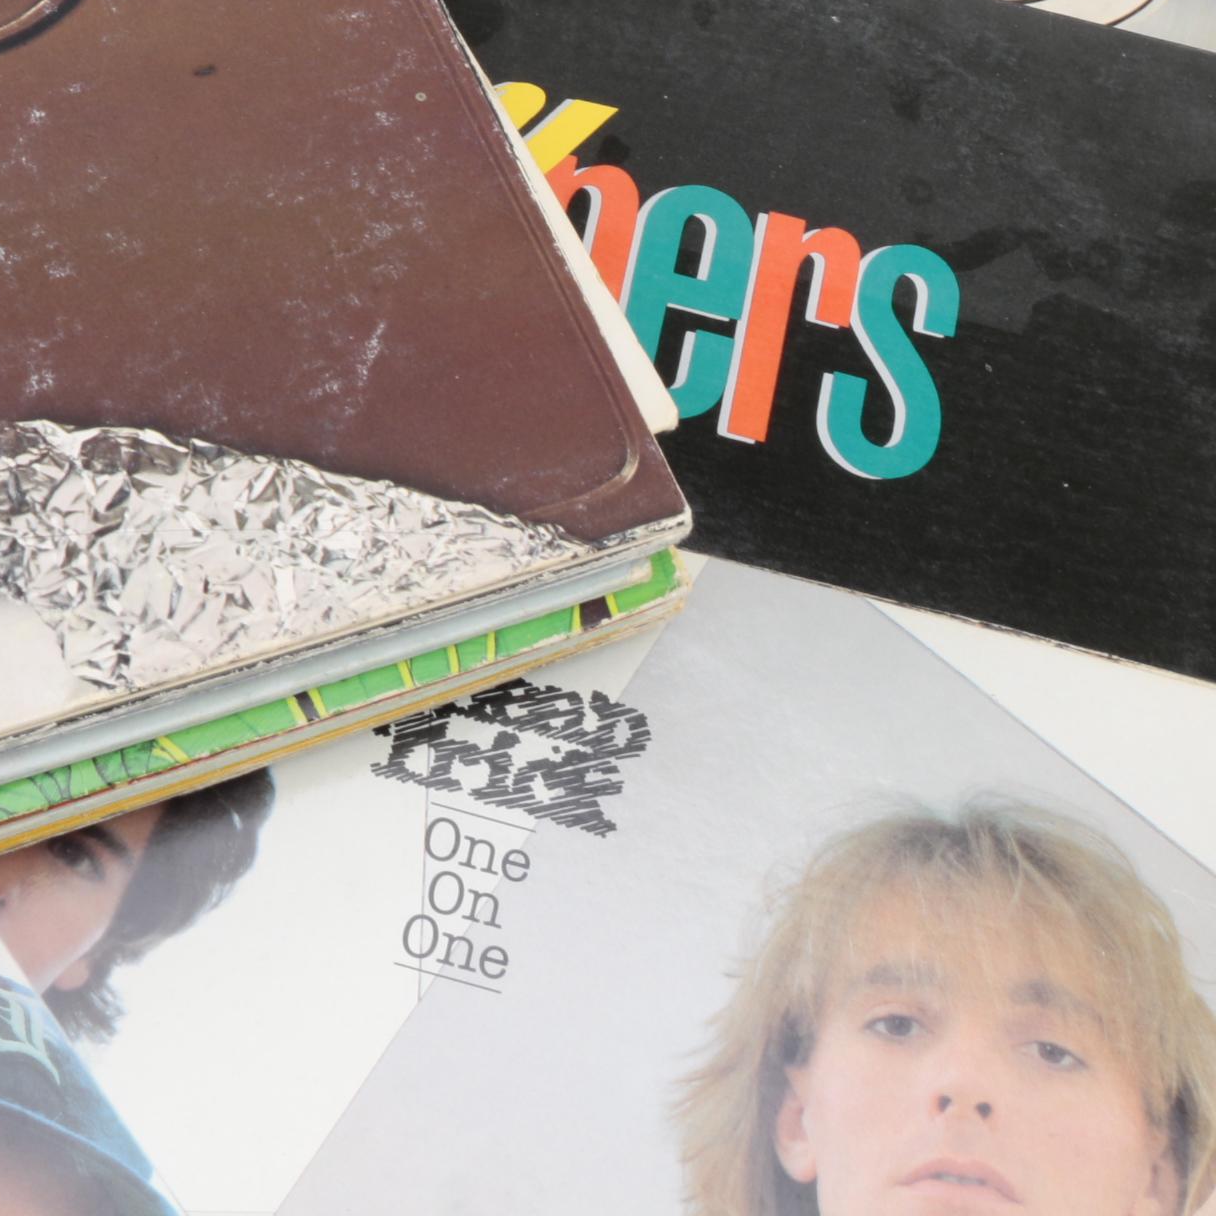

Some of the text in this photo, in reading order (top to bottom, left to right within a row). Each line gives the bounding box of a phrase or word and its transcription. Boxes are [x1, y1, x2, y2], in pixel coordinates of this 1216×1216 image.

[424, 817, 532, 883] One
[427, 870, 503, 930] On
[401, 913, 510, 981] One
